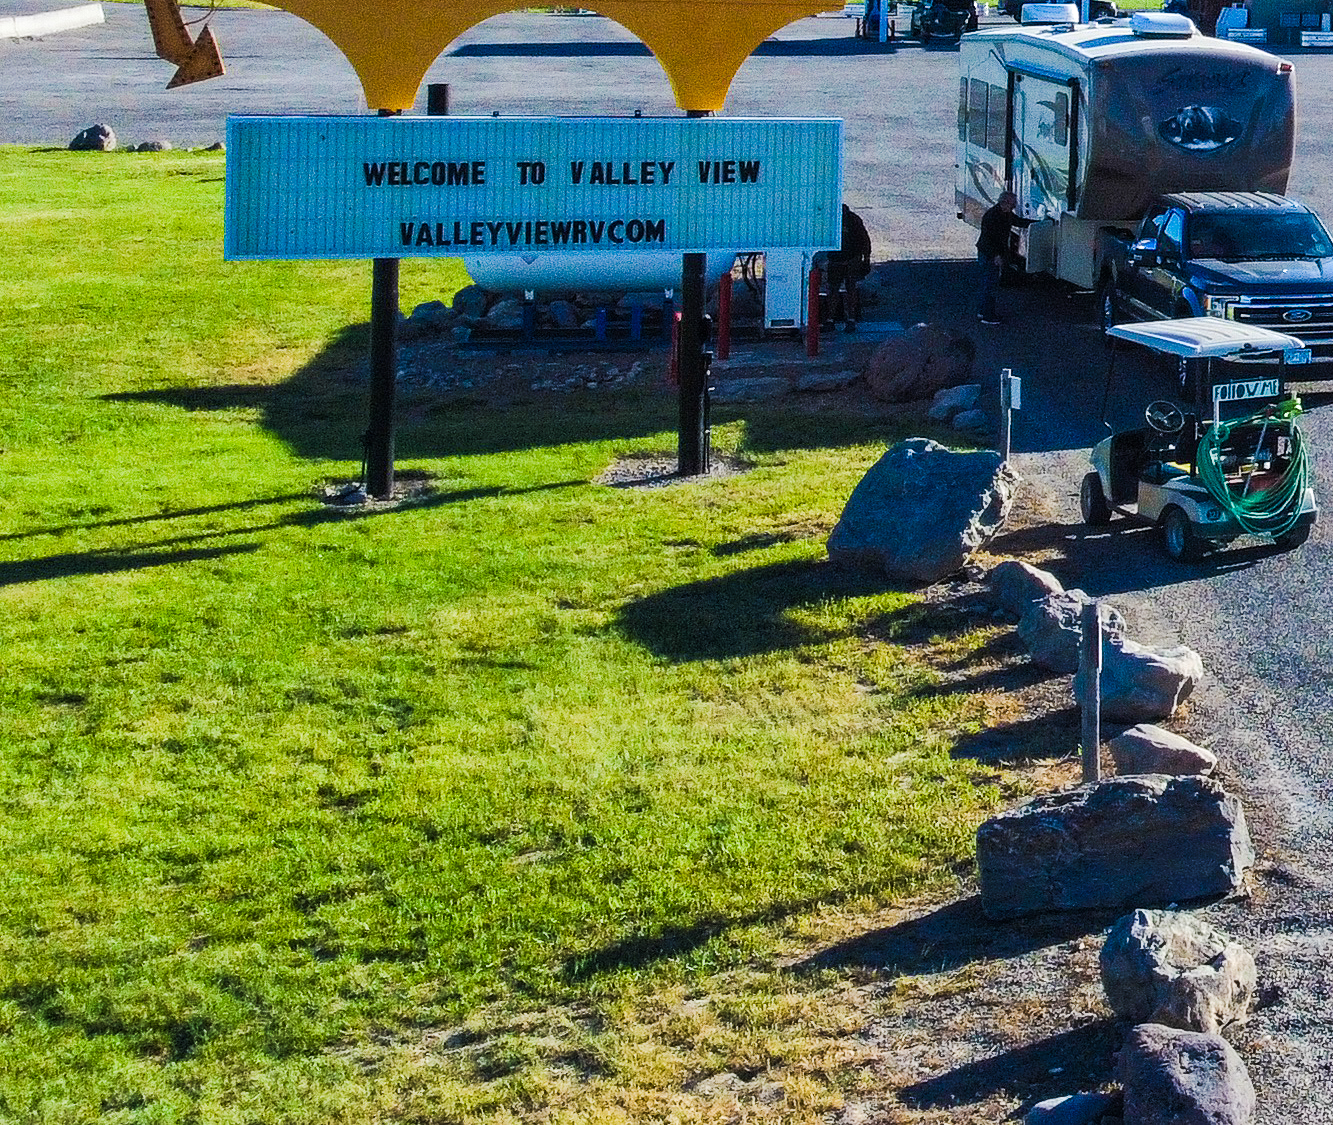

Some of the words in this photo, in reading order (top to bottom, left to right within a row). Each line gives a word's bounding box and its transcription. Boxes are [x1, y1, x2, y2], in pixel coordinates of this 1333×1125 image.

[363, 161, 486, 187] WELCOME
[517, 161, 546, 185] TO
[570, 160, 676, 186] VALLEY
[698, 160, 761, 185] VIEW
[1261, 379, 1278, 395] ME
